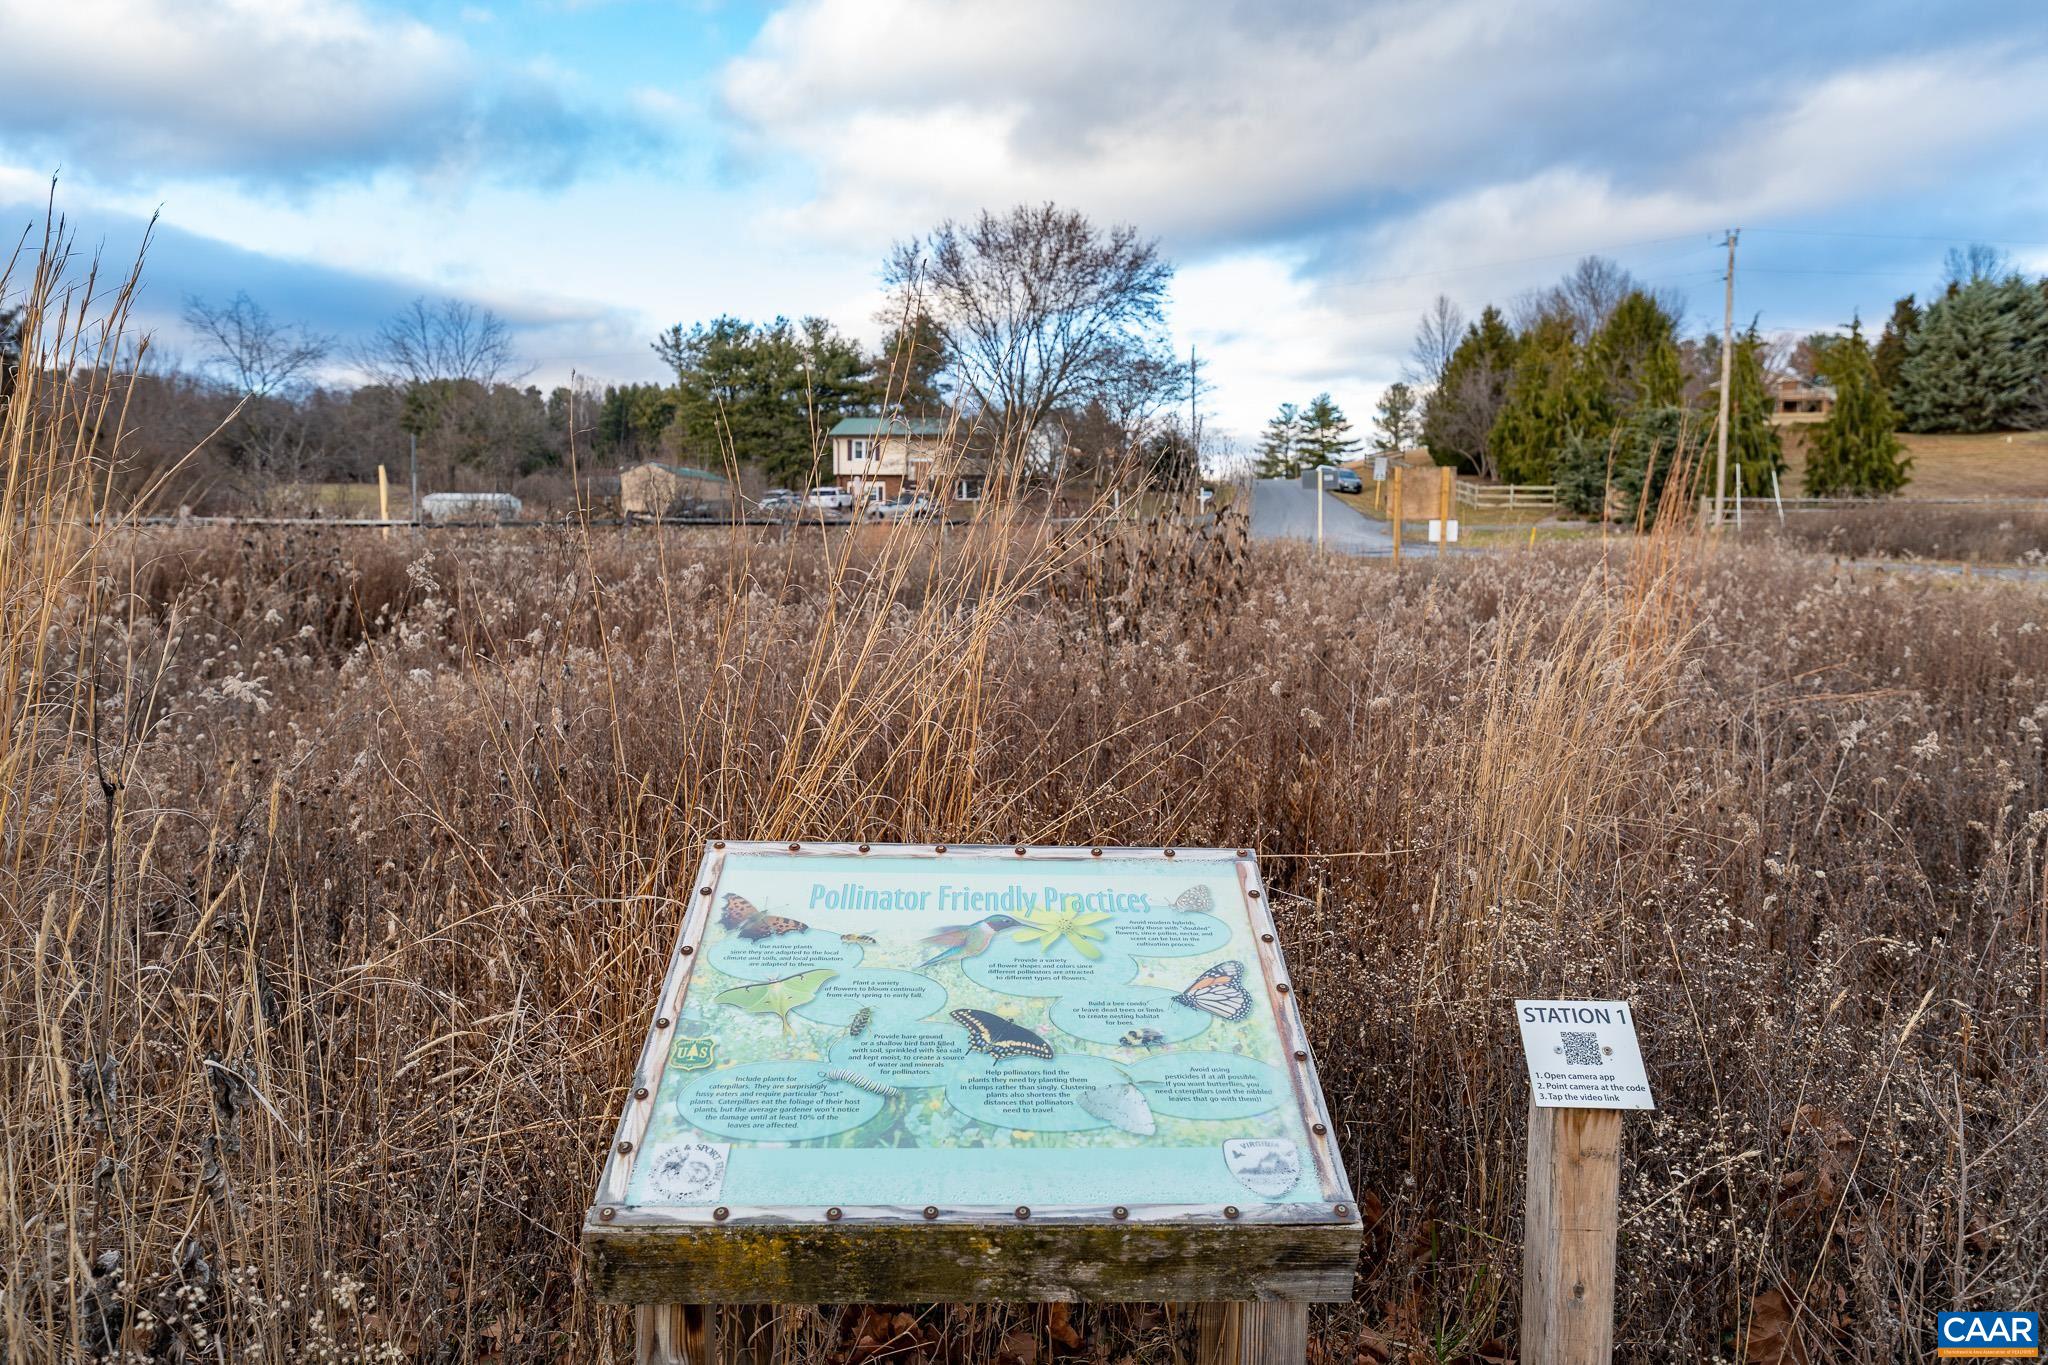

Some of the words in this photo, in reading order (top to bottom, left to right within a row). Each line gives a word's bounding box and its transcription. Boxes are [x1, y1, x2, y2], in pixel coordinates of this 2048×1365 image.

[810, 884, 932, 910] Pollinator
[938, 886, 1036, 917] Friendly
[1044, 887, 1150, 913] Practices
[1524, 1007, 1610, 1024] STATION
[1617, 1009, 1626, 1024] 1
[1549, 1093, 1562, 1101] Tap
